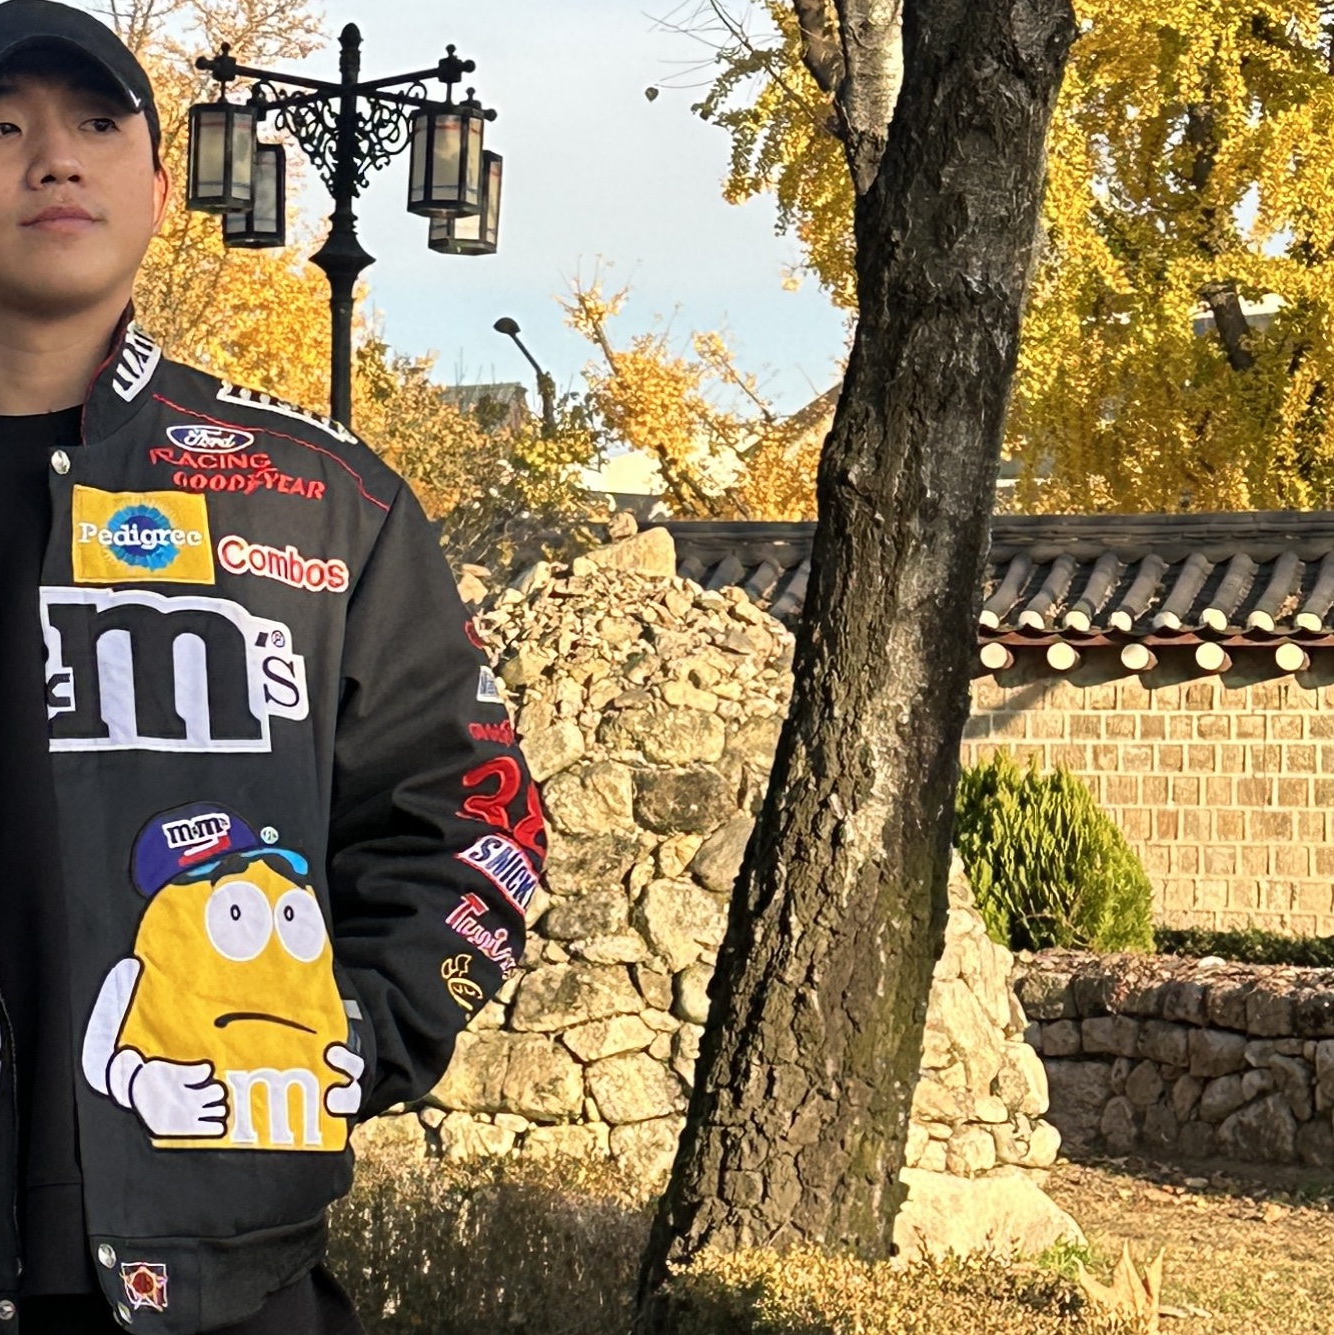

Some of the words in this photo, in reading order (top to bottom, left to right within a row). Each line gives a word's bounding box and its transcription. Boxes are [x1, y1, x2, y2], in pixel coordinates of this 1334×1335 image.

[184, 427, 236, 448] Ford
[149, 447, 272, 470] RACING
[219, 536, 349, 593] Combos
[225, 1068, 323, 1147] m
